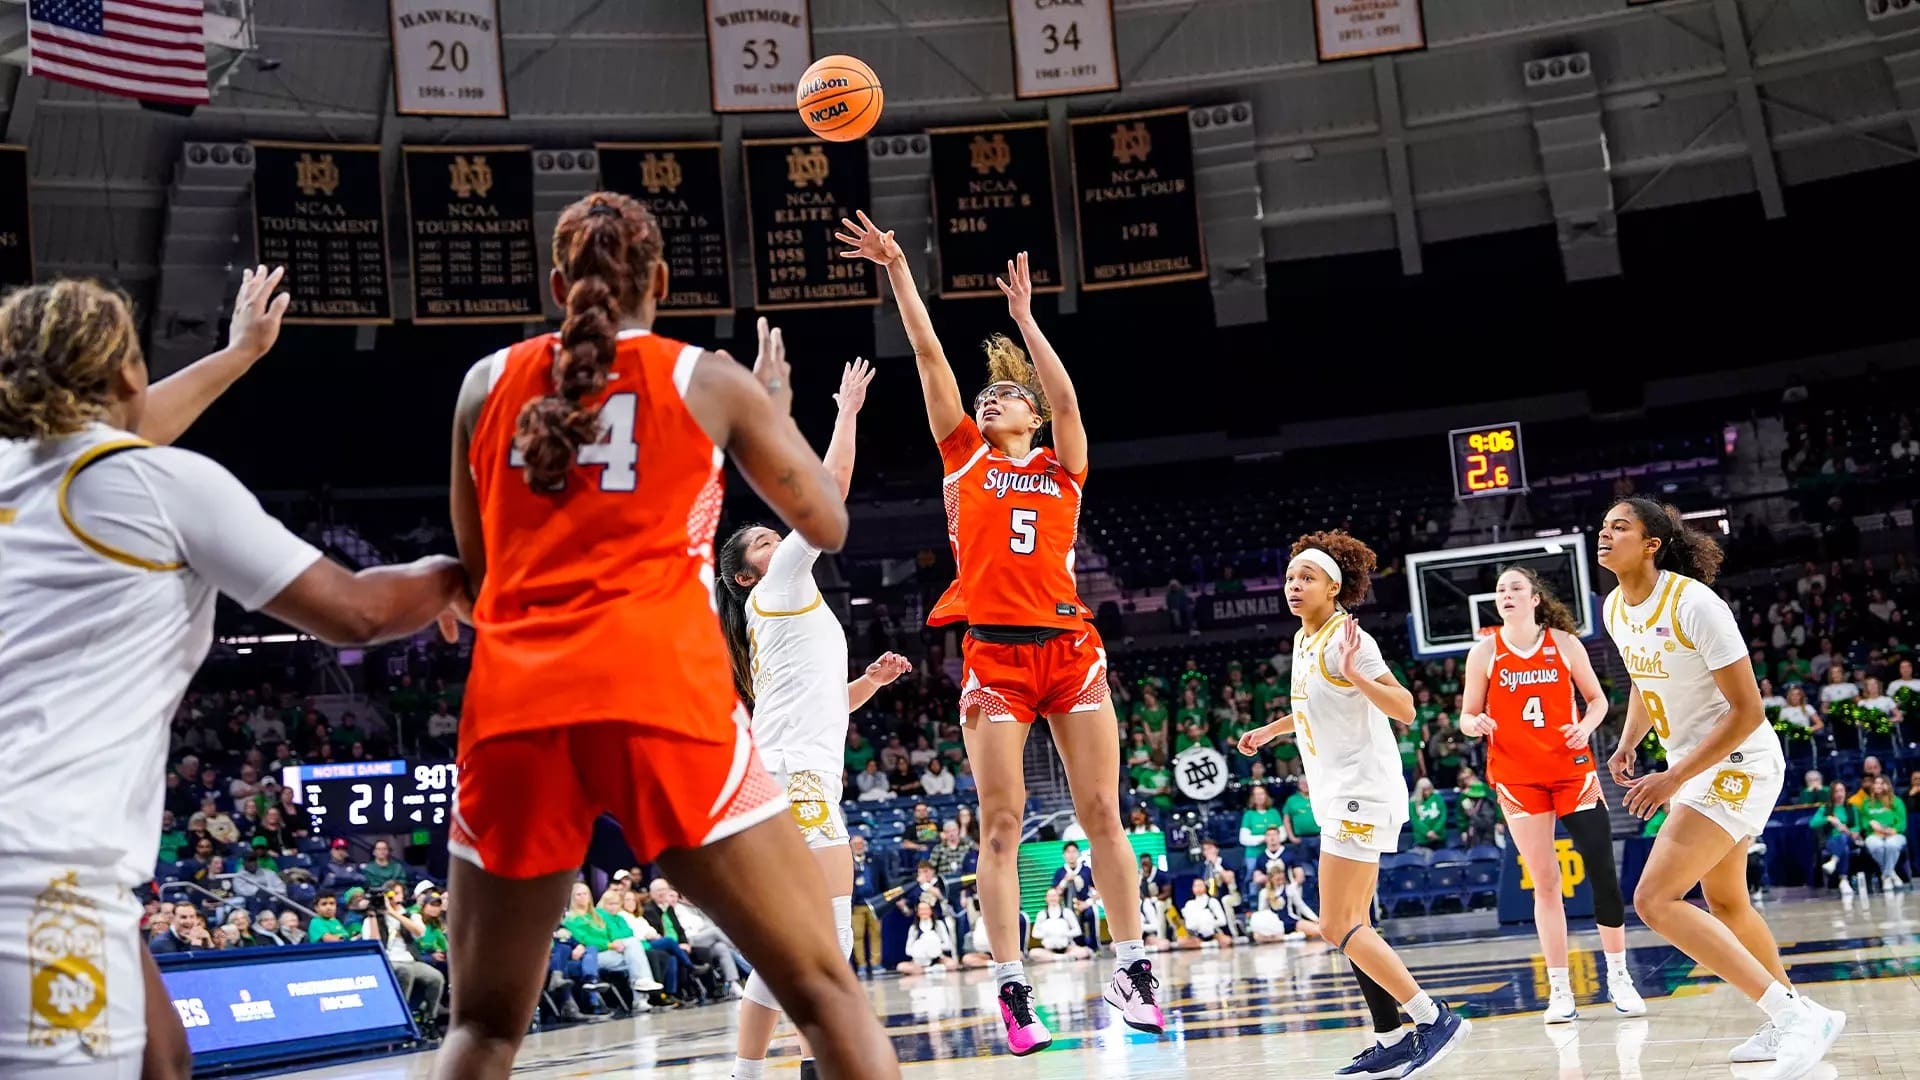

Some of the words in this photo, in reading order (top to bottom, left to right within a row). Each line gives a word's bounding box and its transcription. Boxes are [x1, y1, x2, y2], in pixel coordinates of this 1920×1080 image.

[399, 9, 492, 32] HAWKINS
[715, 9, 801, 28] WHITMORE
[1041, 20, 1082, 55] 34
[426, 39, 469, 73] 20
[741, 38, 781, 70] 53
[800, 75, 848, 100] Wilson
[809, 100, 849, 123] NCAA
[1111, 168, 1158, 183] NCAA
[968, 181, 1018, 193] NCAA
[1085, 186, 1136, 202] FINAL
[785, 192, 834, 206] NCAA
[957, 195, 1014, 211] ELITE
[295, 201, 346, 216] NCAA
[448, 203, 499, 217] NCAA
[775, 207, 832, 223] ELITE
[262, 216, 379, 233] TOURNAMENT
[416, 219, 530, 234] TOURNAMENT
[949, 217, 988, 234] 2016
[1122, 222, 1158, 240] 1978
[767, 229, 803, 246] 1953
[770, 266, 807, 283] 1979
[826, 262, 865, 280] 2015
[1128, 256, 1193, 276] BASKETBALL
[804, 282, 868, 298] BASKETBALL
[311, 300, 378, 314] BASKETBALL
[464, 298, 529, 313] BASKETBALL
[1468, 429, 1515, 453] 9:06
[1466, 454, 1510, 490] 2.6
[983, 467, 1064, 499] Syracuse
[1009, 507, 1038, 556] 5
[1213, 596, 1280, 620] HANNAH
[1622, 645, 1670, 679] Irish
[1499, 667, 1560, 693] Syracuse
[1521, 694, 1546, 730] 4
[1641, 689, 1670, 739] 8
[312, 766, 355, 778] NOTRE
[357, 763, 393, 776] DAME
[349, 783, 394, 825] 21
